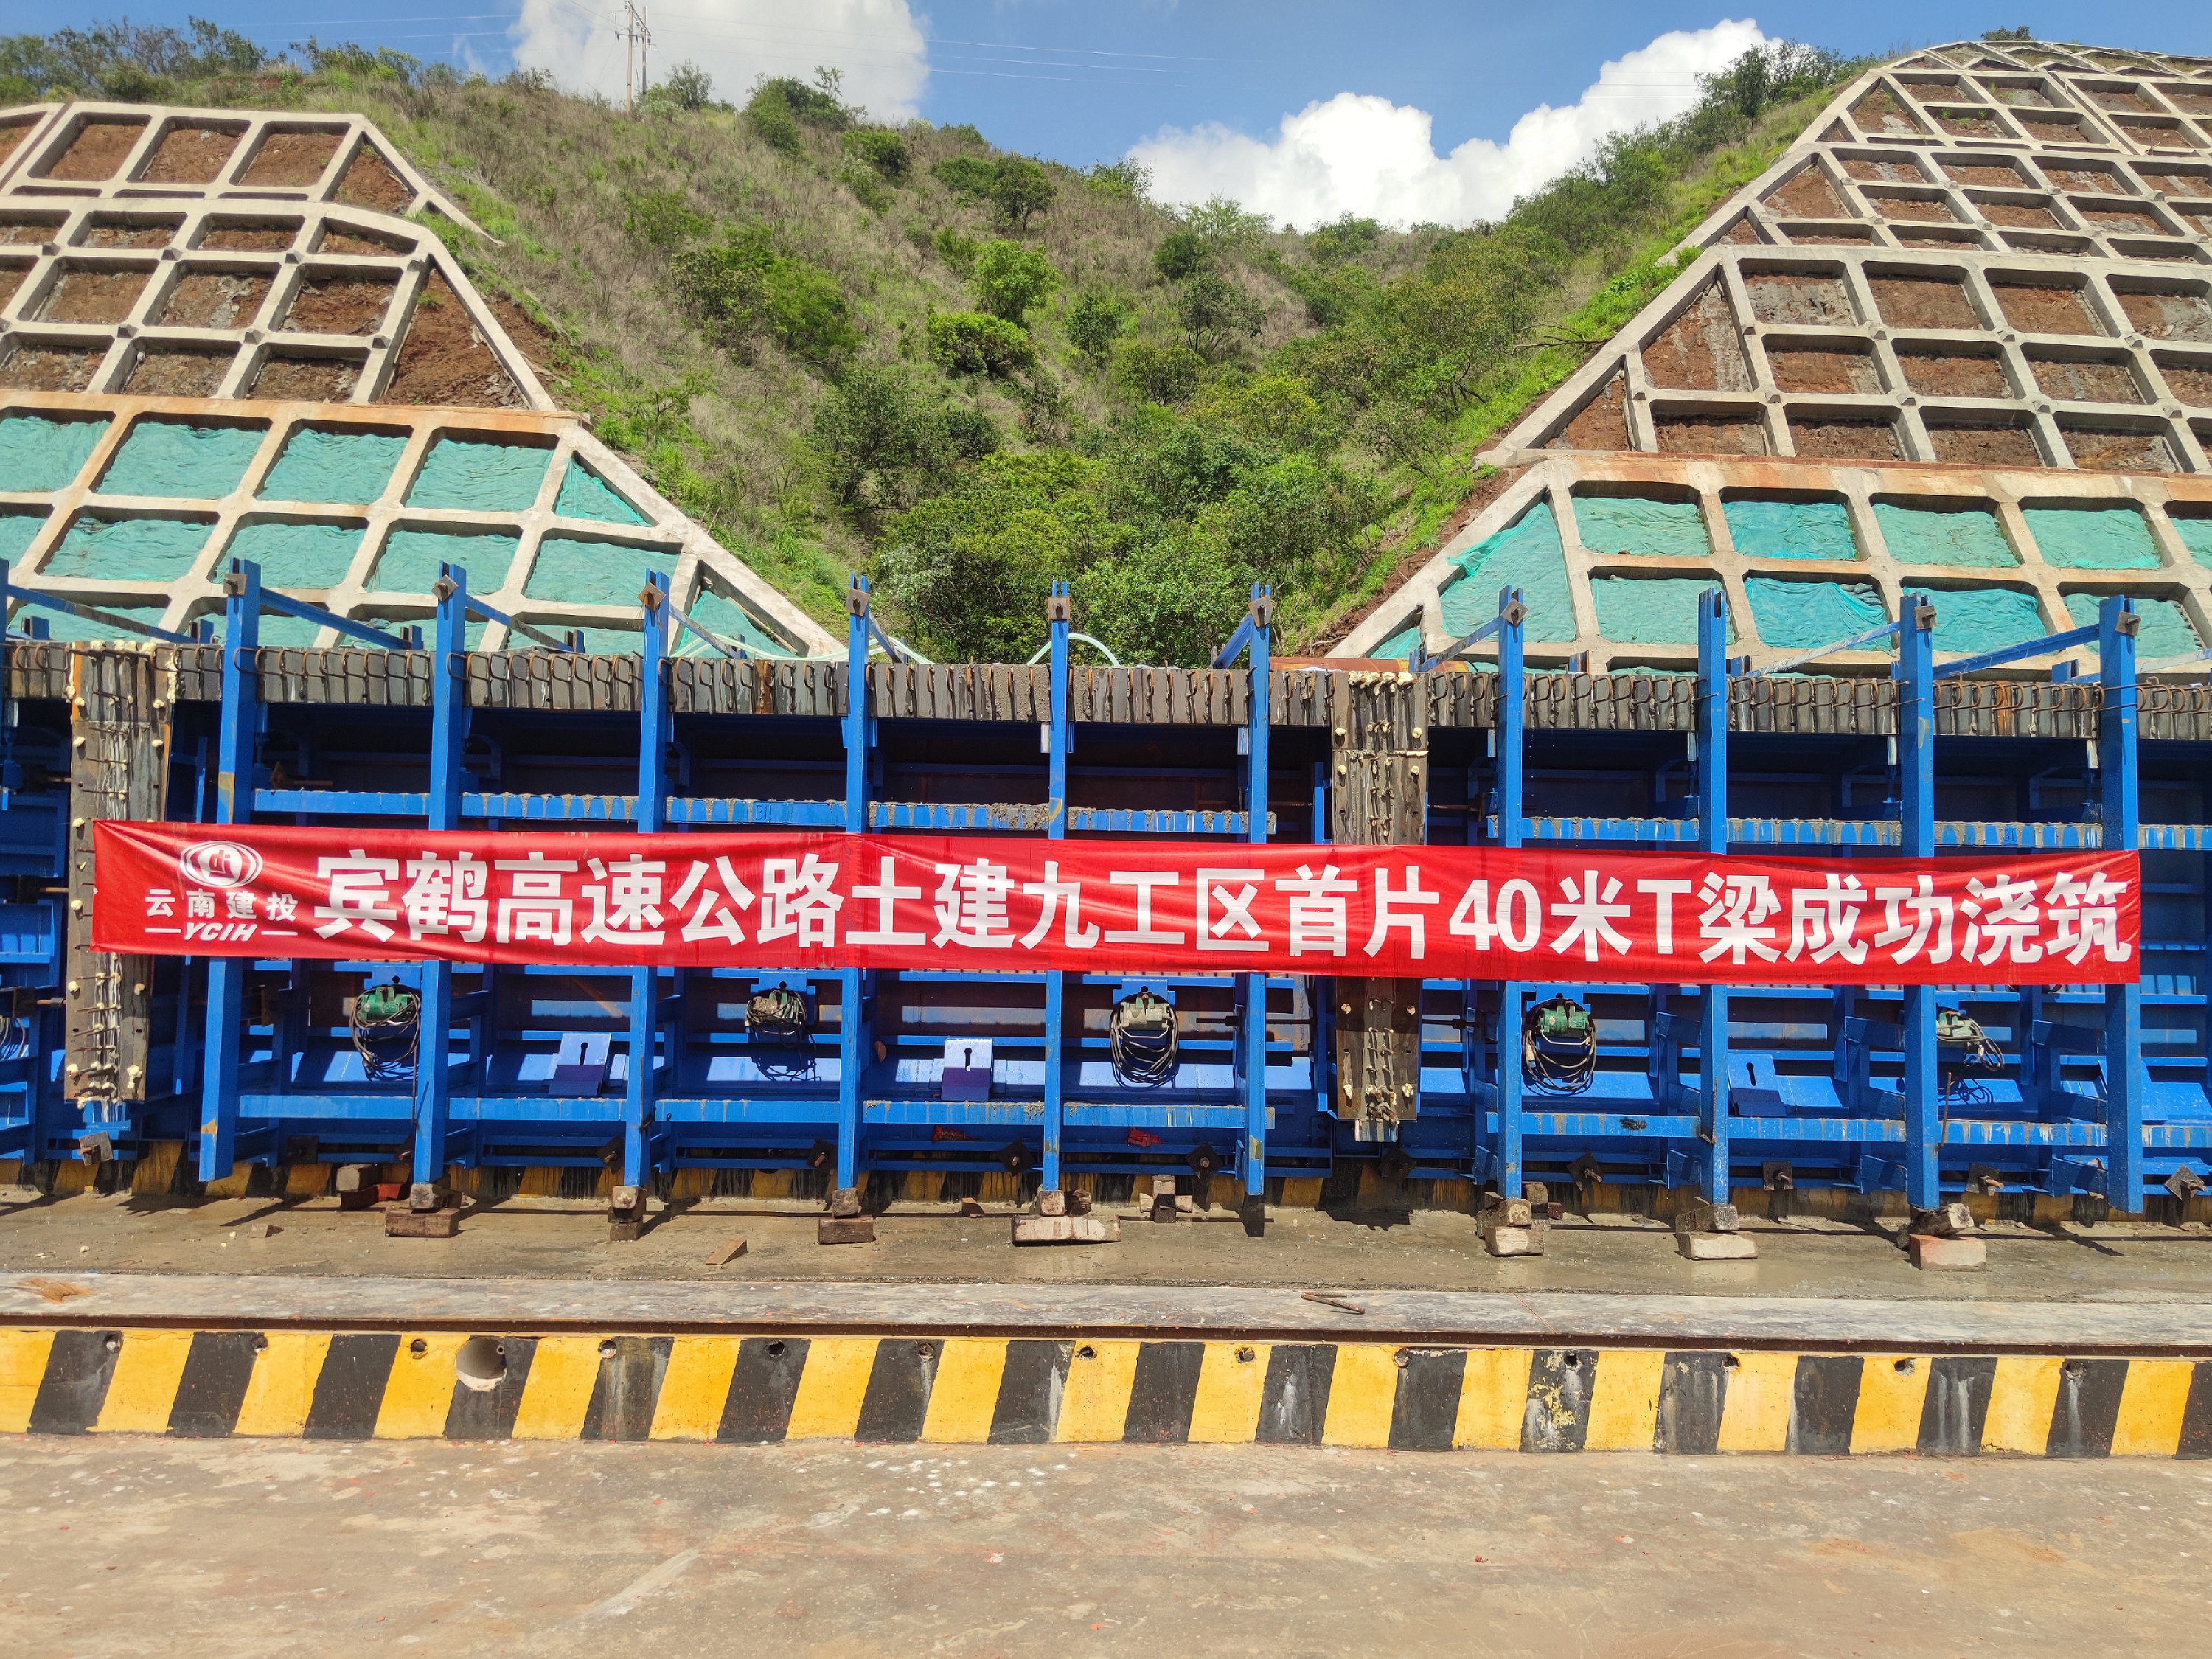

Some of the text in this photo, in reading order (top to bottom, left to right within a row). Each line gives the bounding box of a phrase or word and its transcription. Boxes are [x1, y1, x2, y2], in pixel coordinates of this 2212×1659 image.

[145, 888, 299, 922] 云南建投
[314, 849, 2132, 966] 宾鹤高速公路土建九工区首片40米T梁成功浇筑
[184, 922, 258, 942] YCIH
